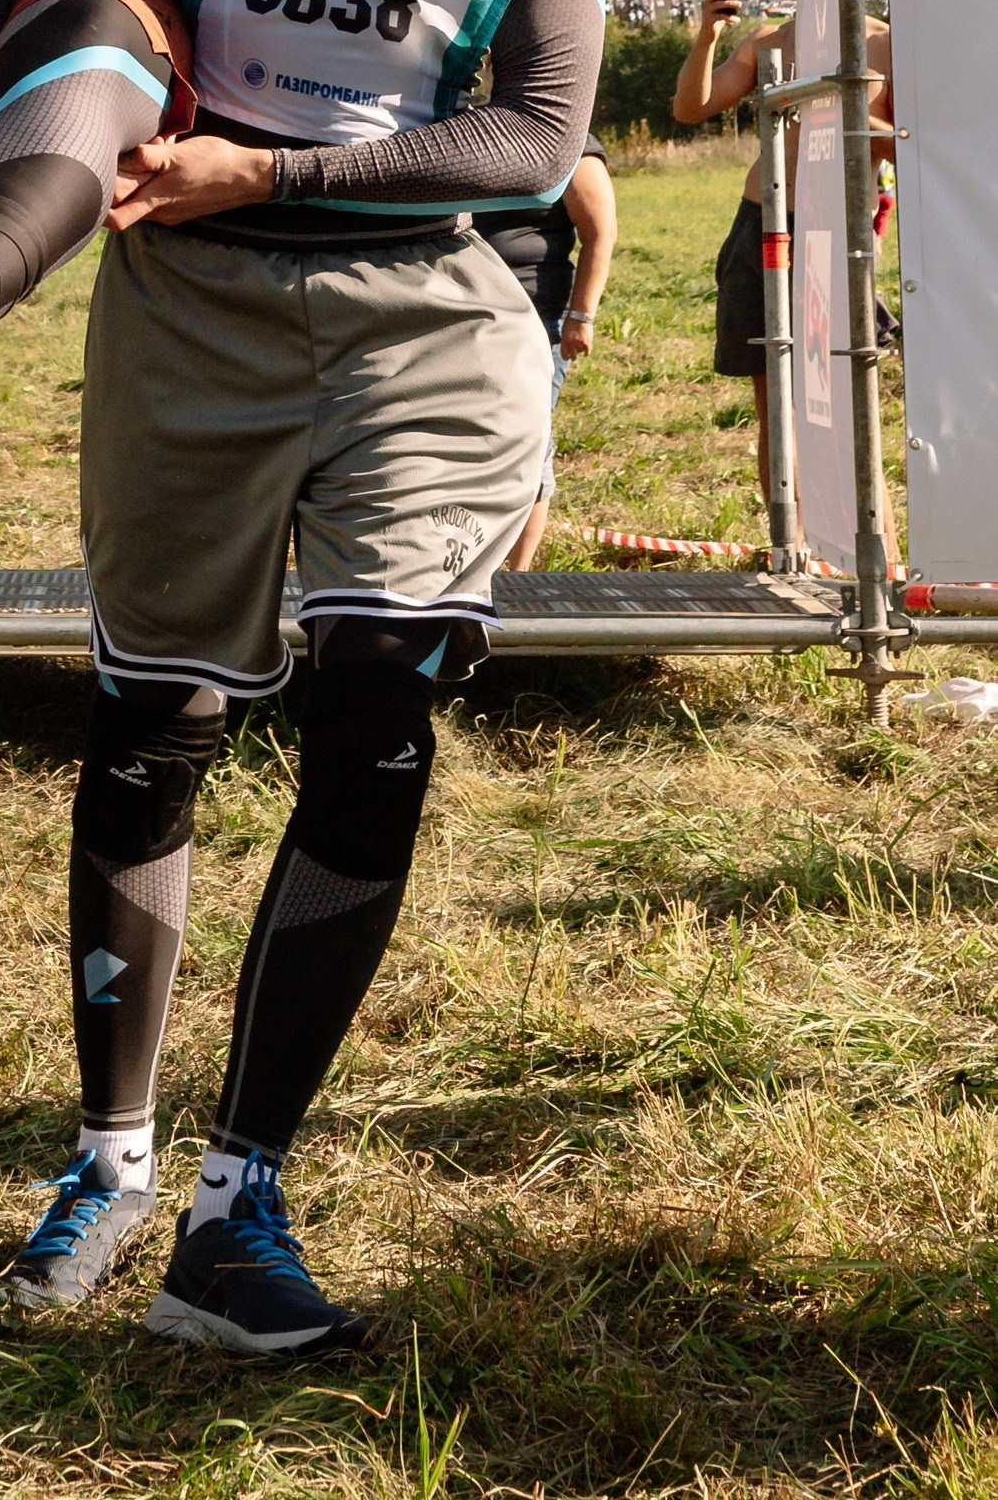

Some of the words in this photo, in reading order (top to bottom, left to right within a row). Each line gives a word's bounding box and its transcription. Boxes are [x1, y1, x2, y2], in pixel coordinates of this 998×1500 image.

[275, 73, 382, 108] ГАЗПРОМБАНК
[431, 505, 485, 548] BROOKLYN
[443, 537, 469, 578] 35
[109, 767, 152, 788] DEMIX
[377, 760, 419, 770] DEMIX
